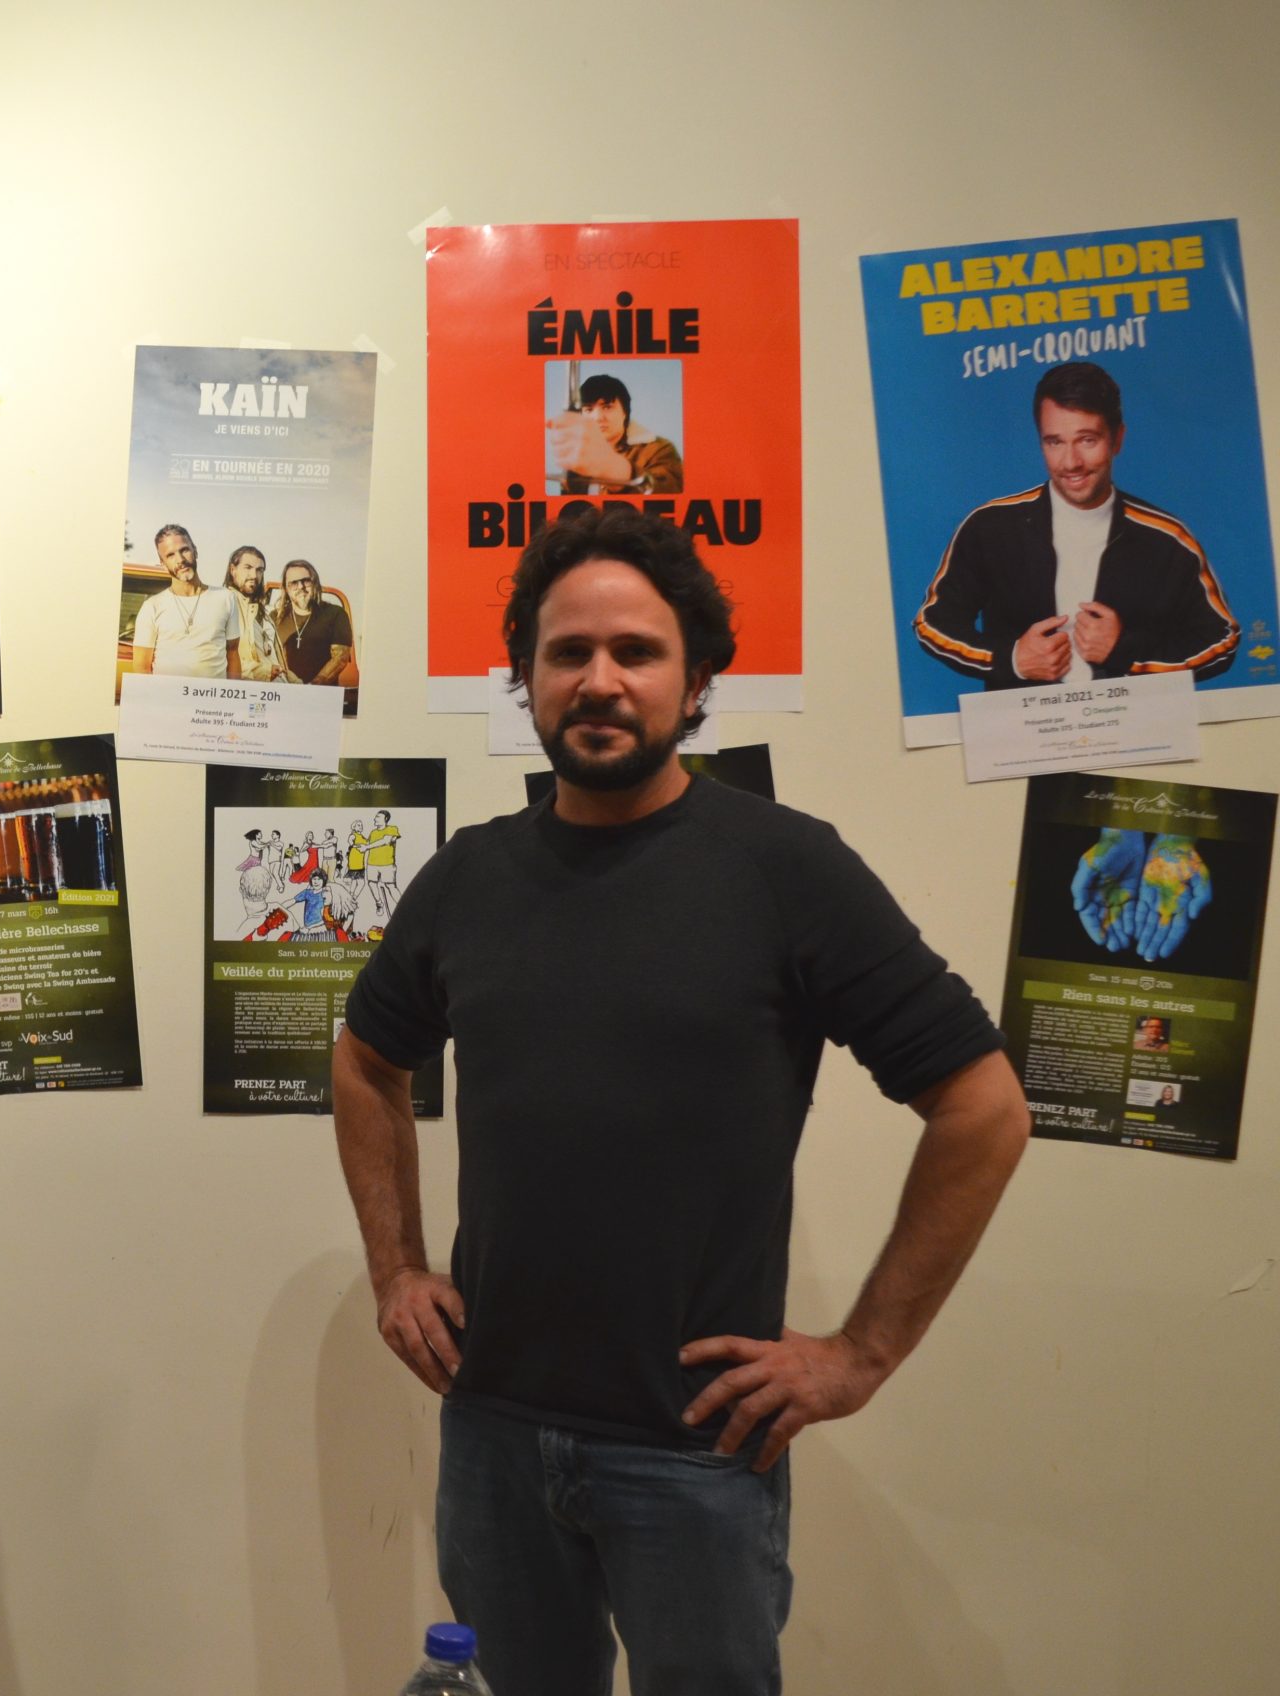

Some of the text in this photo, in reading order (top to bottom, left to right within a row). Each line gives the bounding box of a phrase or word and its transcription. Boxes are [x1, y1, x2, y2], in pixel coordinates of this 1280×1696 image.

[544, 251, 681, 271] EN SPECTACLE
[899, 235, 1205, 299] ALEXANDRE
[920, 277, 1190, 336] BARRETTE
[962, 316, 1147, 378] SEMI-CROQUANT
[198, 376, 308, 418] KAÏN
[215, 424, 289, 437] JE VIENS D'ICI
[192, 459, 330, 477] EN TOURNÉE EN 2020
[468, 483, 762, 548] BIAU
[182, 686, 281, 702] 3 avril 2021 20h
[1040, 693, 1061, 705] mai
[1065, 690, 1093, 703] 2021
[1107, 686, 1129, 698] 20h
[195, 708, 222, 717] Présenté
[190, 717, 211, 725] Adulte
[61, 891, 115, 902] Édition 2021
[8, 909, 27, 919] mars
[44, 906, 59, 916] 16h
[26, 921, 100, 938] Bellechasse
[9, 943, 65, 955] microbrasseries
[27, 954, 36, 962] et
[37, 952, 71, 961] amateurs
[83, 949, 102, 958] bière
[299, 949, 308, 958] 10
[310, 949, 329, 958] avril
[346, 950, 371, 959] 19h30
[17, 964, 28, 972] du
[90, 967, 99, 975] et
[221, 965, 354, 980] Veillée du printemps
[43, 980, 51, 988] la
[52, 978, 74, 988] Swing
[75, 975, 116, 985] Ambassade
[1062, 988, 1195, 1013] Rien sans les autres
[52, 1029, 73, 1042] Sud
[234, 1079, 306, 1089] PRENEZ PART
[258, 1088, 282, 1101] votre
[283, 1088, 324, 1102] culture!
[1068, 1106, 1098, 1118] PART
